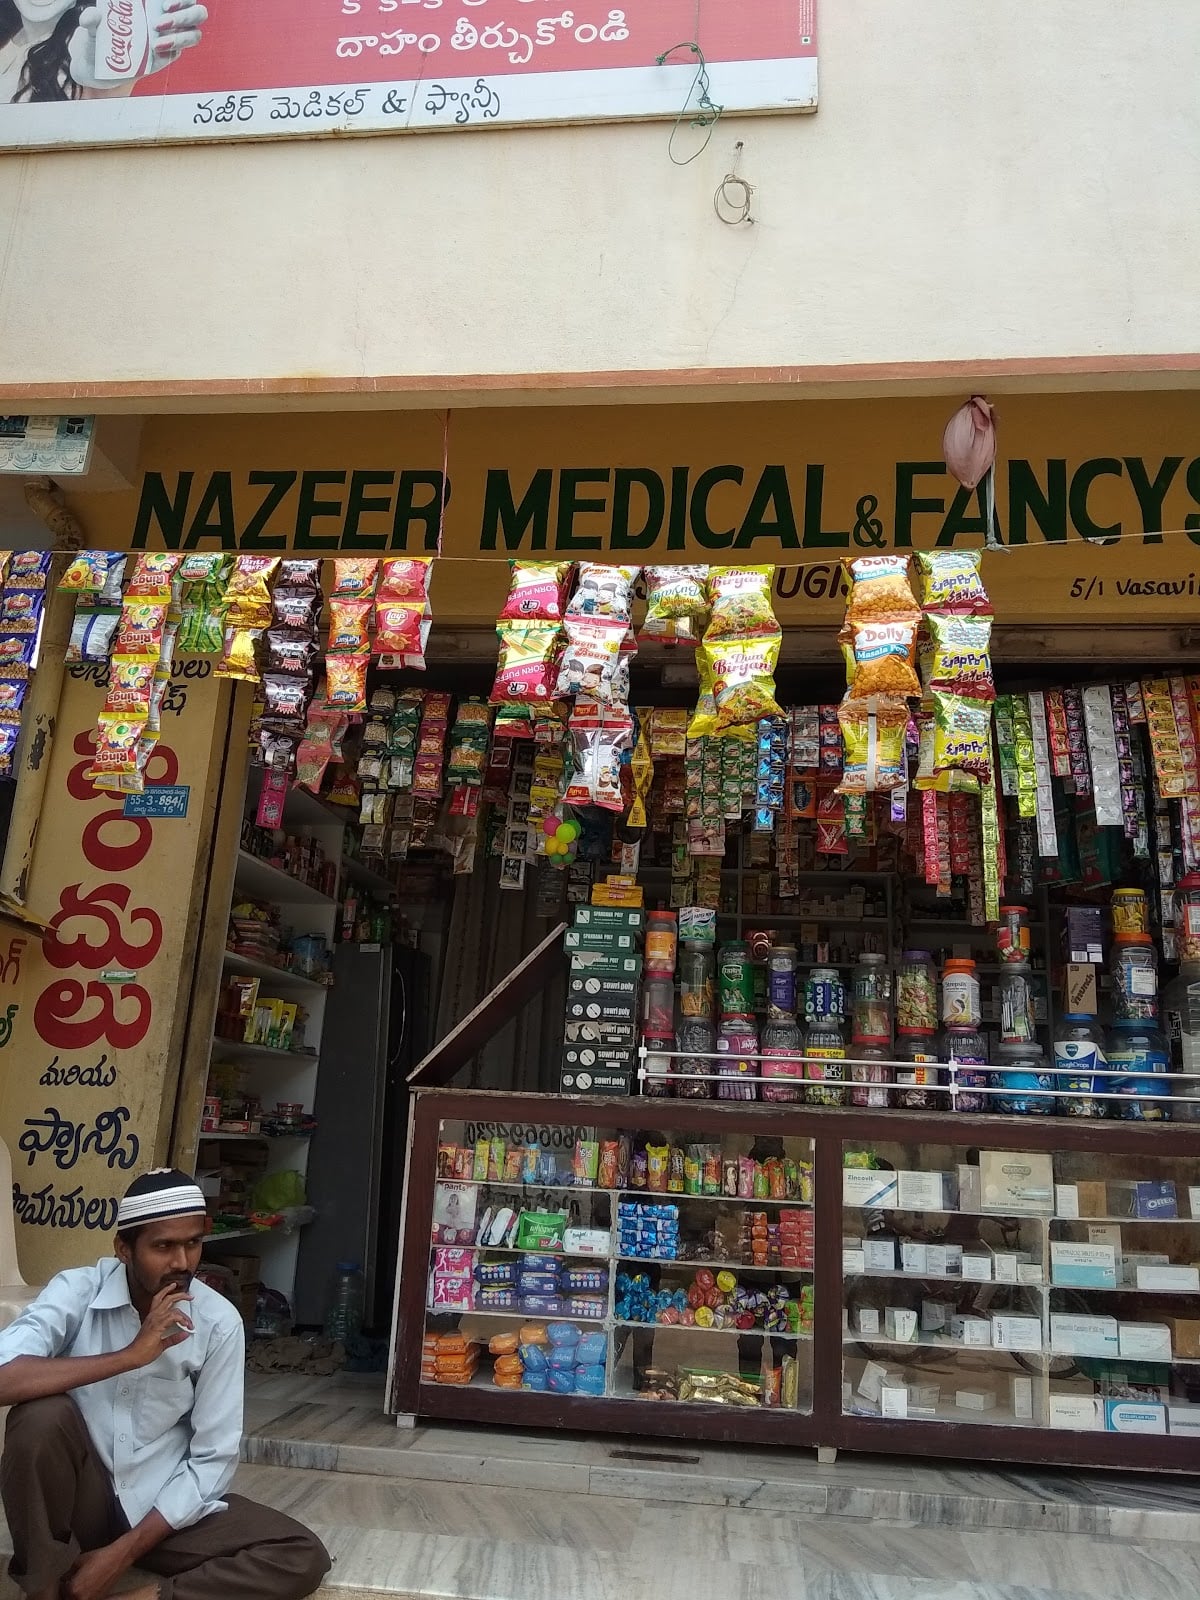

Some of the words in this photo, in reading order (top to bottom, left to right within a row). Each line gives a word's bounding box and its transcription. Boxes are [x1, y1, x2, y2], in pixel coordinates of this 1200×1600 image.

[336, 29, 441, 58] దాహం
[193, 95, 258, 124] నజీర్
[270, 89, 372, 120] మెడికల్
[382, 90, 407, 114] &
[425, 79, 501, 124] ఫ్యాన్సీ
[131, 470, 452, 551] NAZEER
[480, 467, 850, 550] MEDICAL
[853, 494, 888, 548] &
[861, 557, 899, 568] Dolly
[532, 584, 558, 595] CORN
[1116, 573, 1200, 596] Vasavi
[865, 627, 904, 643] Dolly
[856, 646, 889, 660] Masala
[521, 664, 546, 676] CORN
[618, 982, 635, 992] poly
[816, 984, 824, 1013] POLO
[617, 1008, 631, 1017] poly
[617, 1027, 631, 1036] poly
[614, 1051, 630, 1060] poly
[39, 1054, 117, 1087] మరియు
[610, 1077, 626, 1087] poly
[18, 1106, 140, 1170] ఫ్యాన్సీ
[847, 1174, 874, 1182] Zincovit
[444, 1183, 467, 1192] pants
